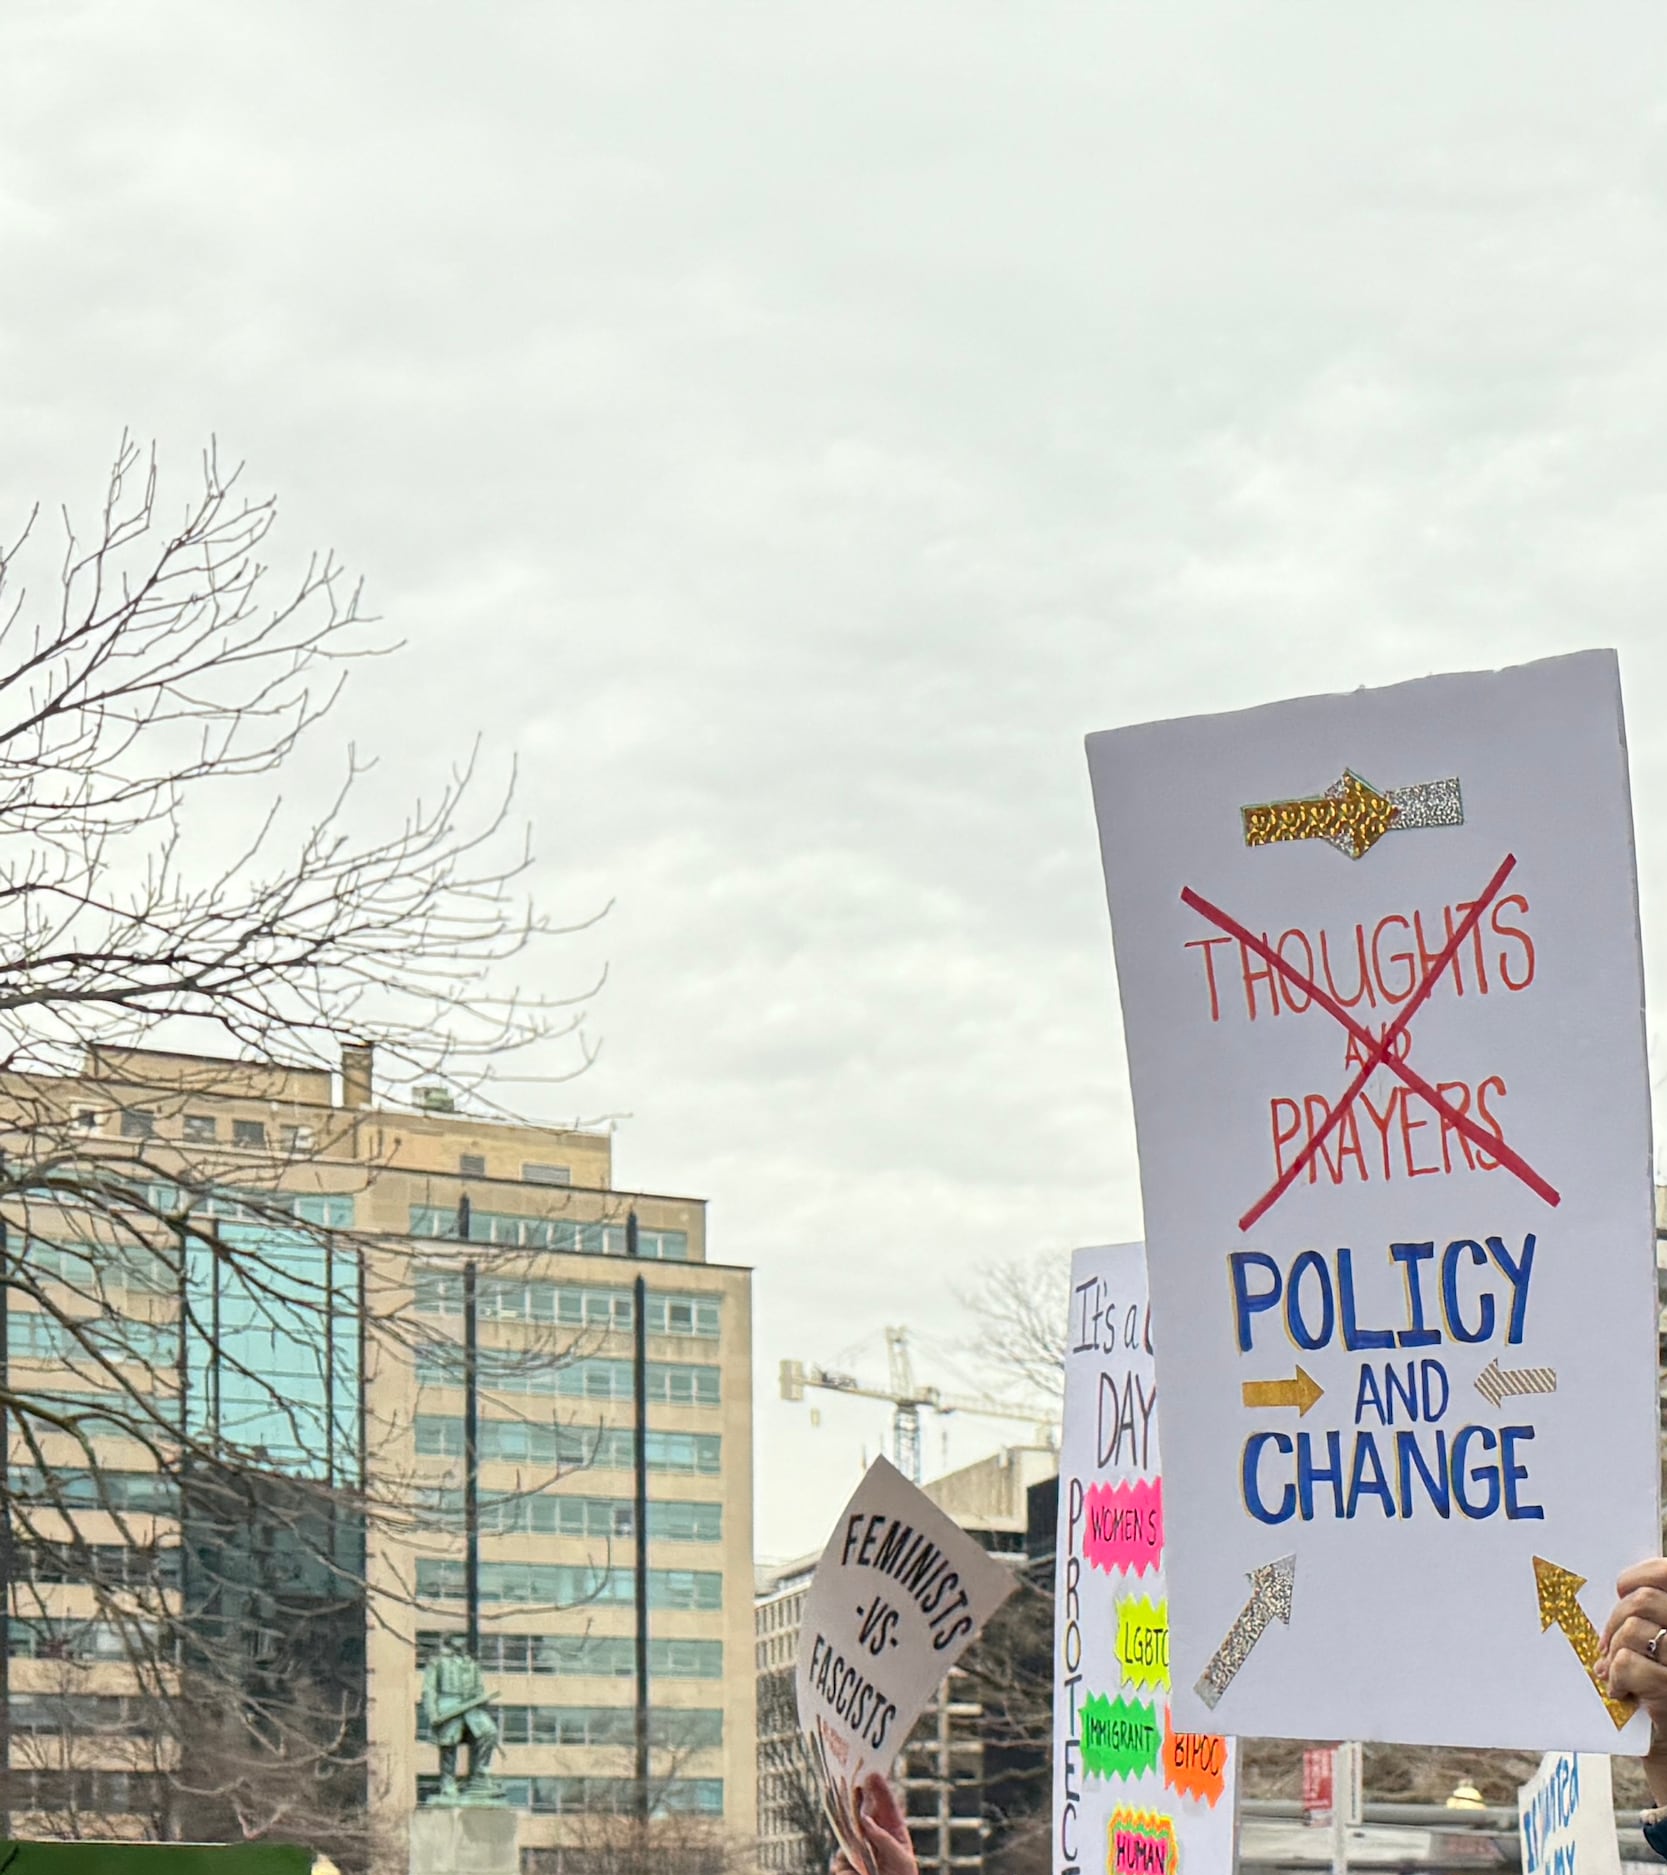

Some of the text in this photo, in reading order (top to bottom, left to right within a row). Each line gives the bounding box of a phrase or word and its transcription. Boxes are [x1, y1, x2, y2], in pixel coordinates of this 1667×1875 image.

[1184, 894, 1535, 1021] THOUGHTS
[1344, 1022, 1412, 1071] AND
[1270, 1074, 1507, 1185] PRAYERS
[1226, 1233, 1537, 1354] POLICY
[1097, 1370, 1158, 1470] DAY
[1354, 1357, 1450, 1426] AND
[1239, 1423, 1545, 1526] CHANGE
[840, 1513, 973, 1651] FEMINISTS
[808, 1632, 897, 1750] FASCISTS
[1086, 1716, 1155, 1753] IMMIGRANT
[1115, 1836, 1166, 1875] HUMAN
